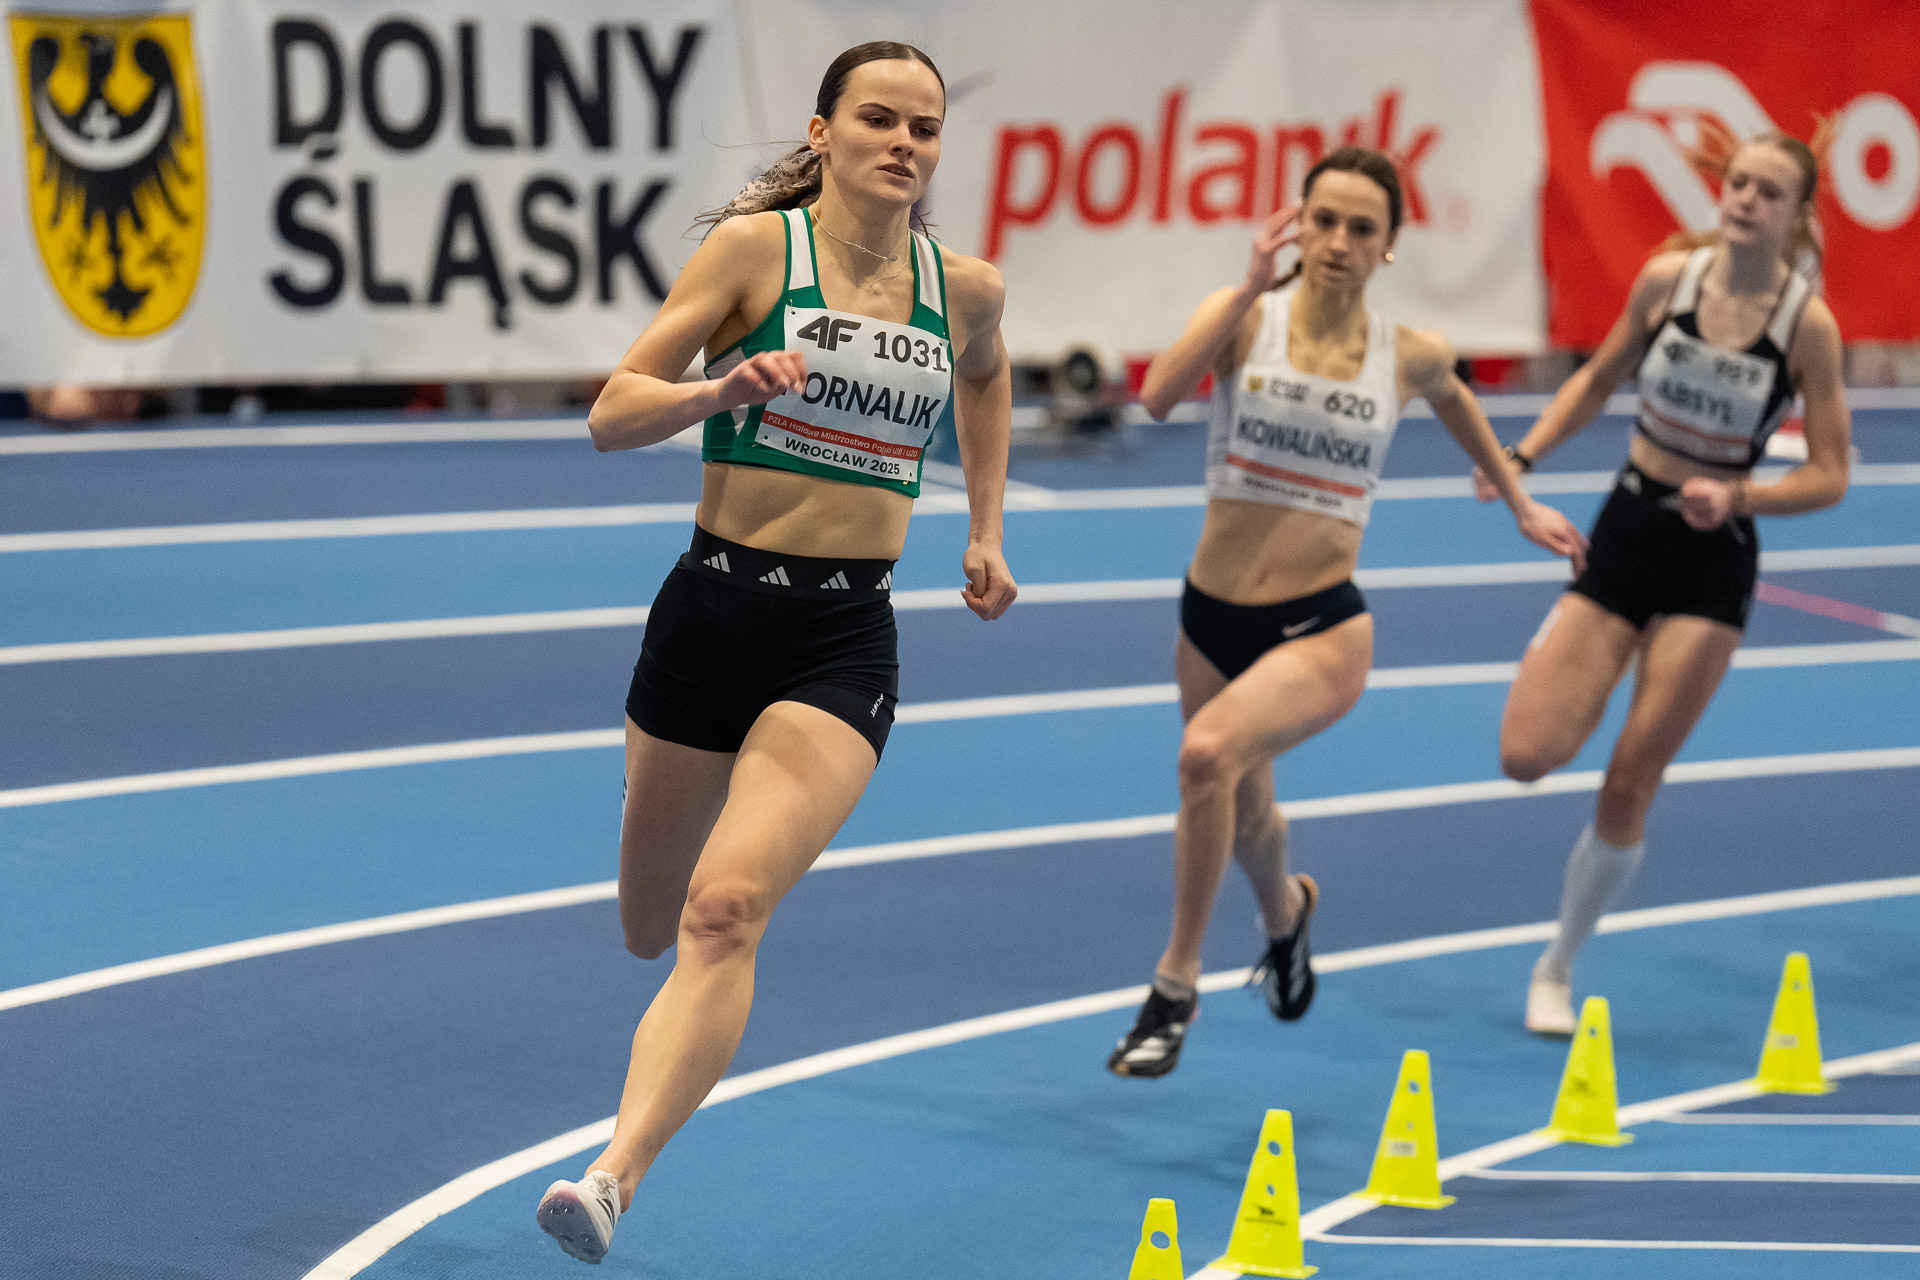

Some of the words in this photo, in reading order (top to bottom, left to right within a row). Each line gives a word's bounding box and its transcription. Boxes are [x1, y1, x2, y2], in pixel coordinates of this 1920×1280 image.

[270, 18, 707, 152] DOLNY
[267, 131, 676, 328] ŚLĄSK
[797, 315, 862, 351] 4F
[873, 331, 947, 373] 1031
[796, 371, 942, 430] ORNALIK
[1323, 389, 1376, 422] 620
[767, 415, 787, 427] PZLA
[789, 422, 819, 437] Halowe
[821, 428, 870, 449] Mistrzostwa
[785, 437, 868, 468] WROCŁAW
[870, 459, 900, 475] 2025
[1237, 414, 1371, 469] KOWALIŃSKA
